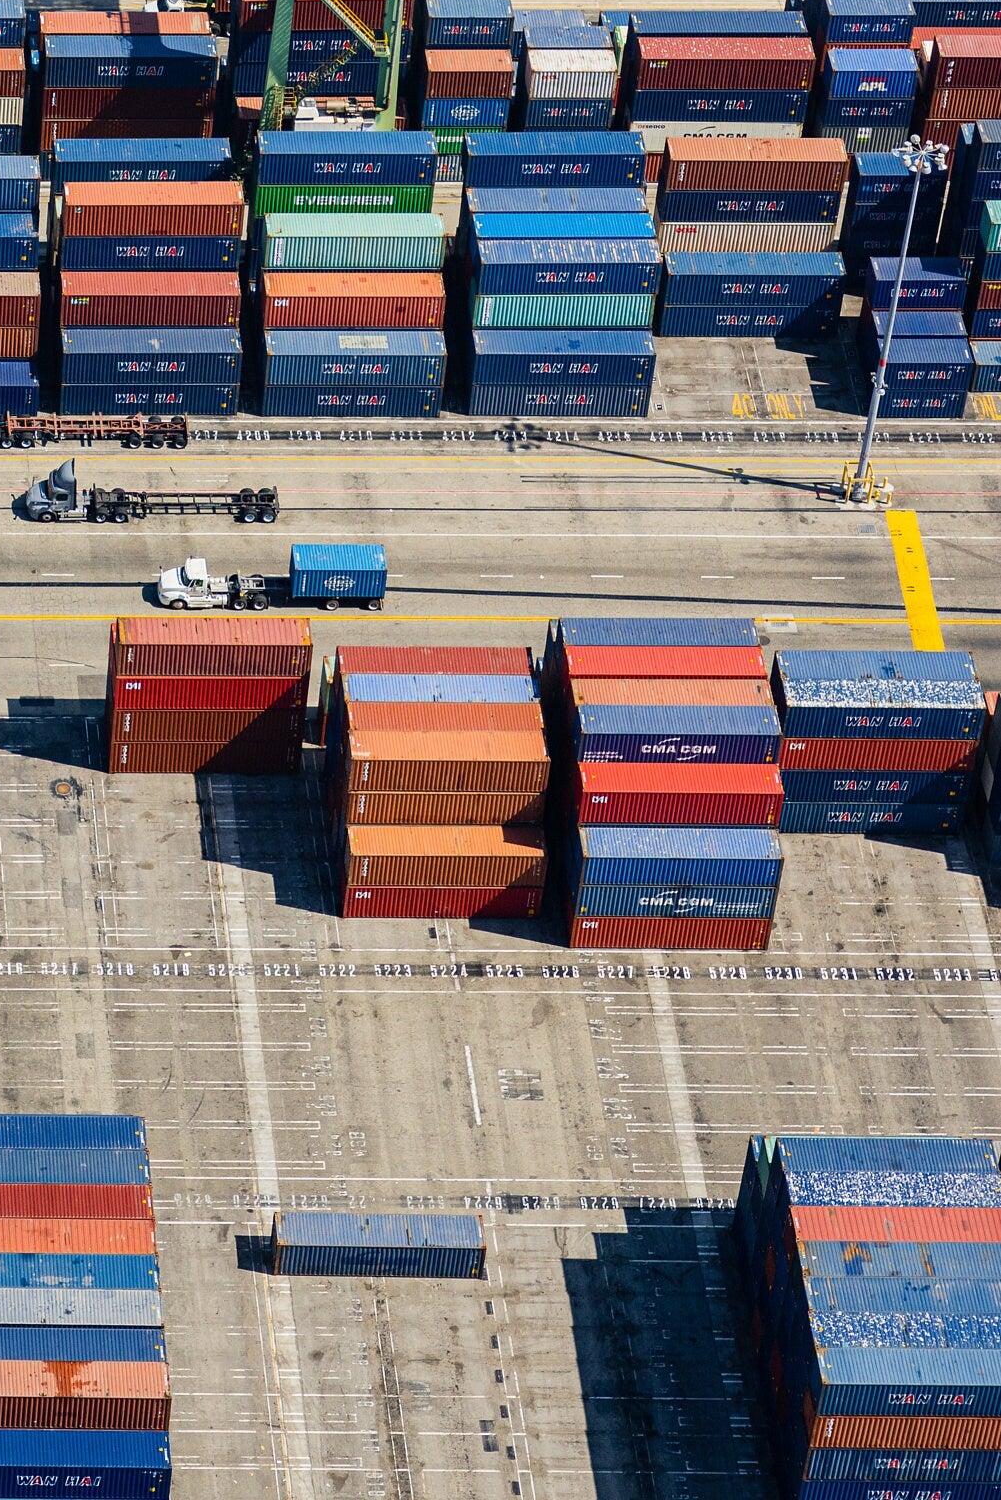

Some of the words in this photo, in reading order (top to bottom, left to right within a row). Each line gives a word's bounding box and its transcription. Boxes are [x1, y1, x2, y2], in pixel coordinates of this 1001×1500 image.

[857, 81, 888, 93] APL
[314, 163, 347, 173] WAN
[352, 163, 381, 173] HAI
[522, 164, 556, 174] WAN
[561, 164, 590, 174] HAI
[294, 195, 394, 206] EVERGREEN
[717, 201, 751, 211] WAN
[755, 201, 784, 211] HAI
[116, 246, 150, 256] WAN
[155, 246, 184, 256] HAI
[322, 364, 355, 374] WAN
[359, 364, 388, 374] HAI
[115, 393, 149, 403] WAN
[155, 393, 183, 403] HAI
[767, 393, 804, 419] ONLY
[846, 716, 884, 727] WAN
[889, 716, 921, 727] HAI
[641, 744, 676, 754] CMA
[680, 744, 717, 754] CGM
[639, 897, 674, 906] CMA
[678, 897, 714, 906] CGM
[152, 962, 190, 975] 5219
[319, 964, 356, 977] 5222
[374, 964, 412, 977] 5223
[430, 964, 468, 977] 5224
[486, 964, 524, 977] 5225
[598, 964, 634, 977] 5227
[764, 967, 802, 980] 5230
[821, 967, 858, 980] 5231
[875, 967, 915, 980] 5232
[889, 1394, 931, 1405] WAN
[937, 1394, 974, 1405] HAI
[17, 1475, 58, 1486] WAN
[65, 1475, 101, 1486] HAI
